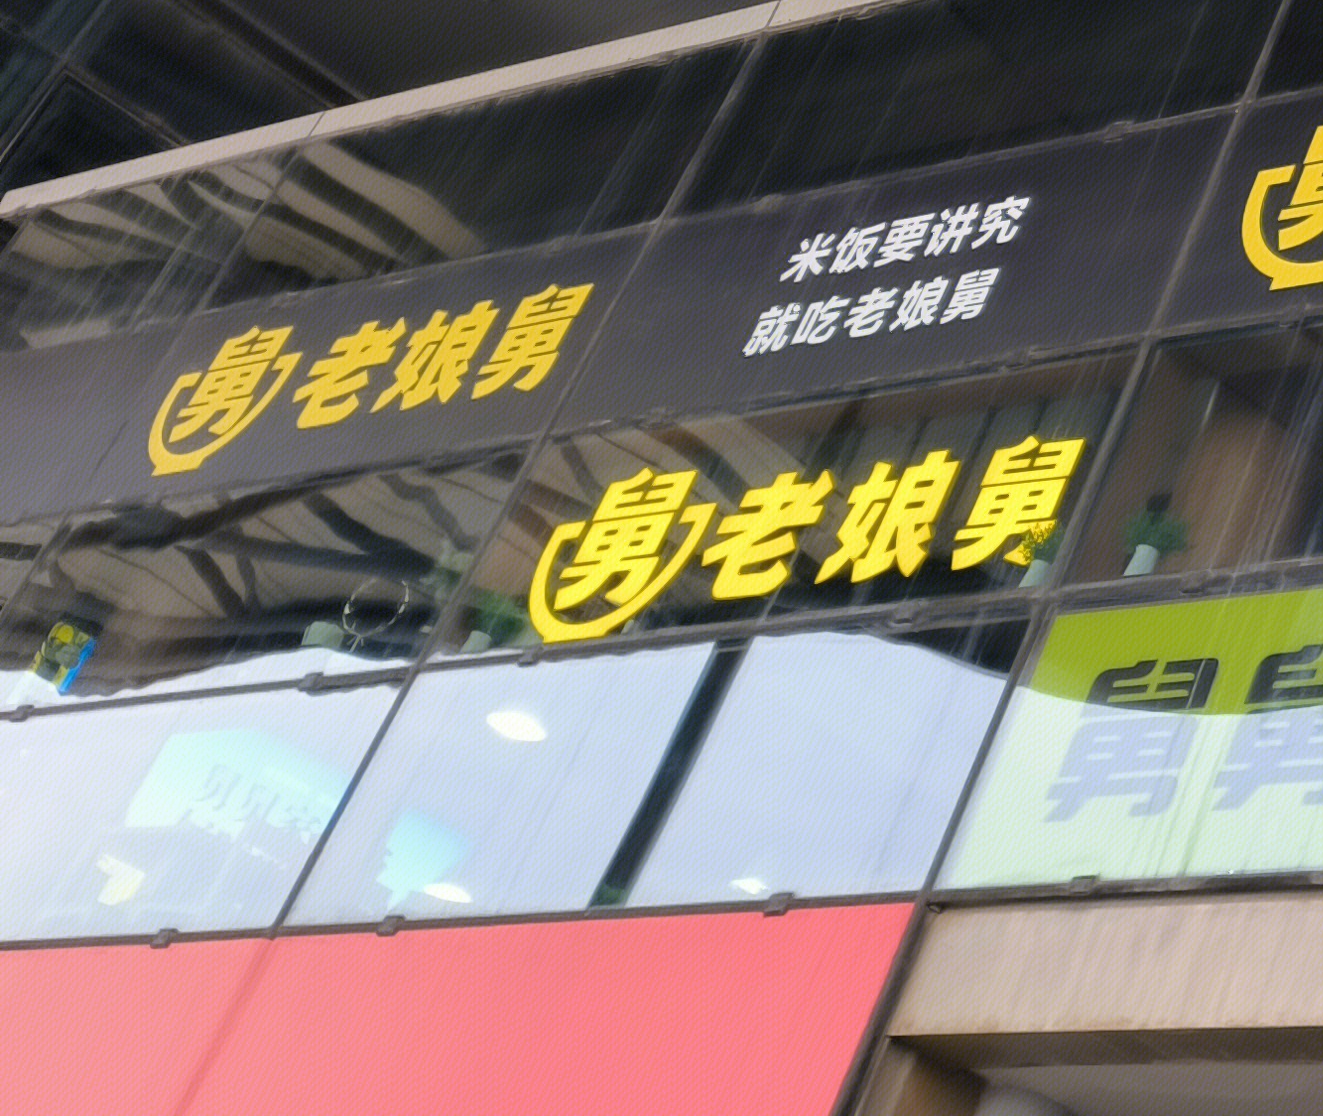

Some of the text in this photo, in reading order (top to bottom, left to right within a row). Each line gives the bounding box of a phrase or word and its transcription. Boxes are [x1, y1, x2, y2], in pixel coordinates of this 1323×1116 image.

[779, 195, 1031, 283] 米饭要讲究
[292, 283, 594, 430] 老娘舅
[742, 267, 1000, 358] 就吃老娘舅
[700, 434, 1087, 600] 老娘舅
